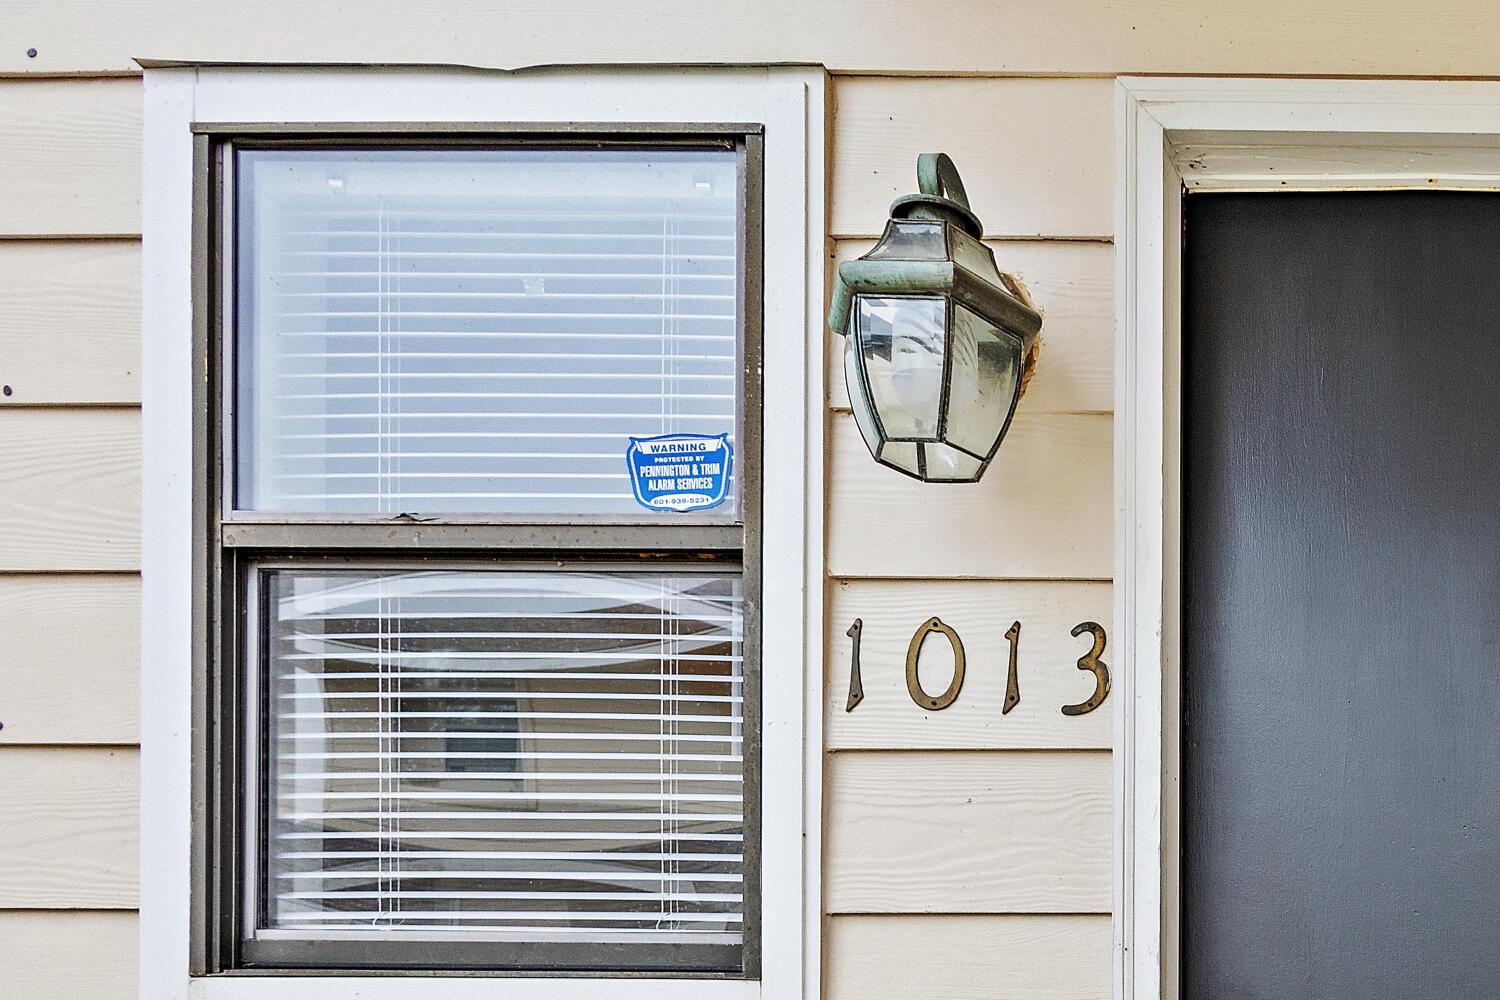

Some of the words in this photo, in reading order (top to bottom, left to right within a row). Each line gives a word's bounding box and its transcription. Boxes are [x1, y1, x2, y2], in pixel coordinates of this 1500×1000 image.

[650, 443, 706, 453] WARNING
[640, 464, 690, 477] PENNINGTON
[692, 464, 699, 476] &
[701, 463, 720, 475] TRIM
[648, 479, 675, 491] ALARM
[677, 477, 713, 490] SERVICES
[845, 616, 1111, 716] 1013
